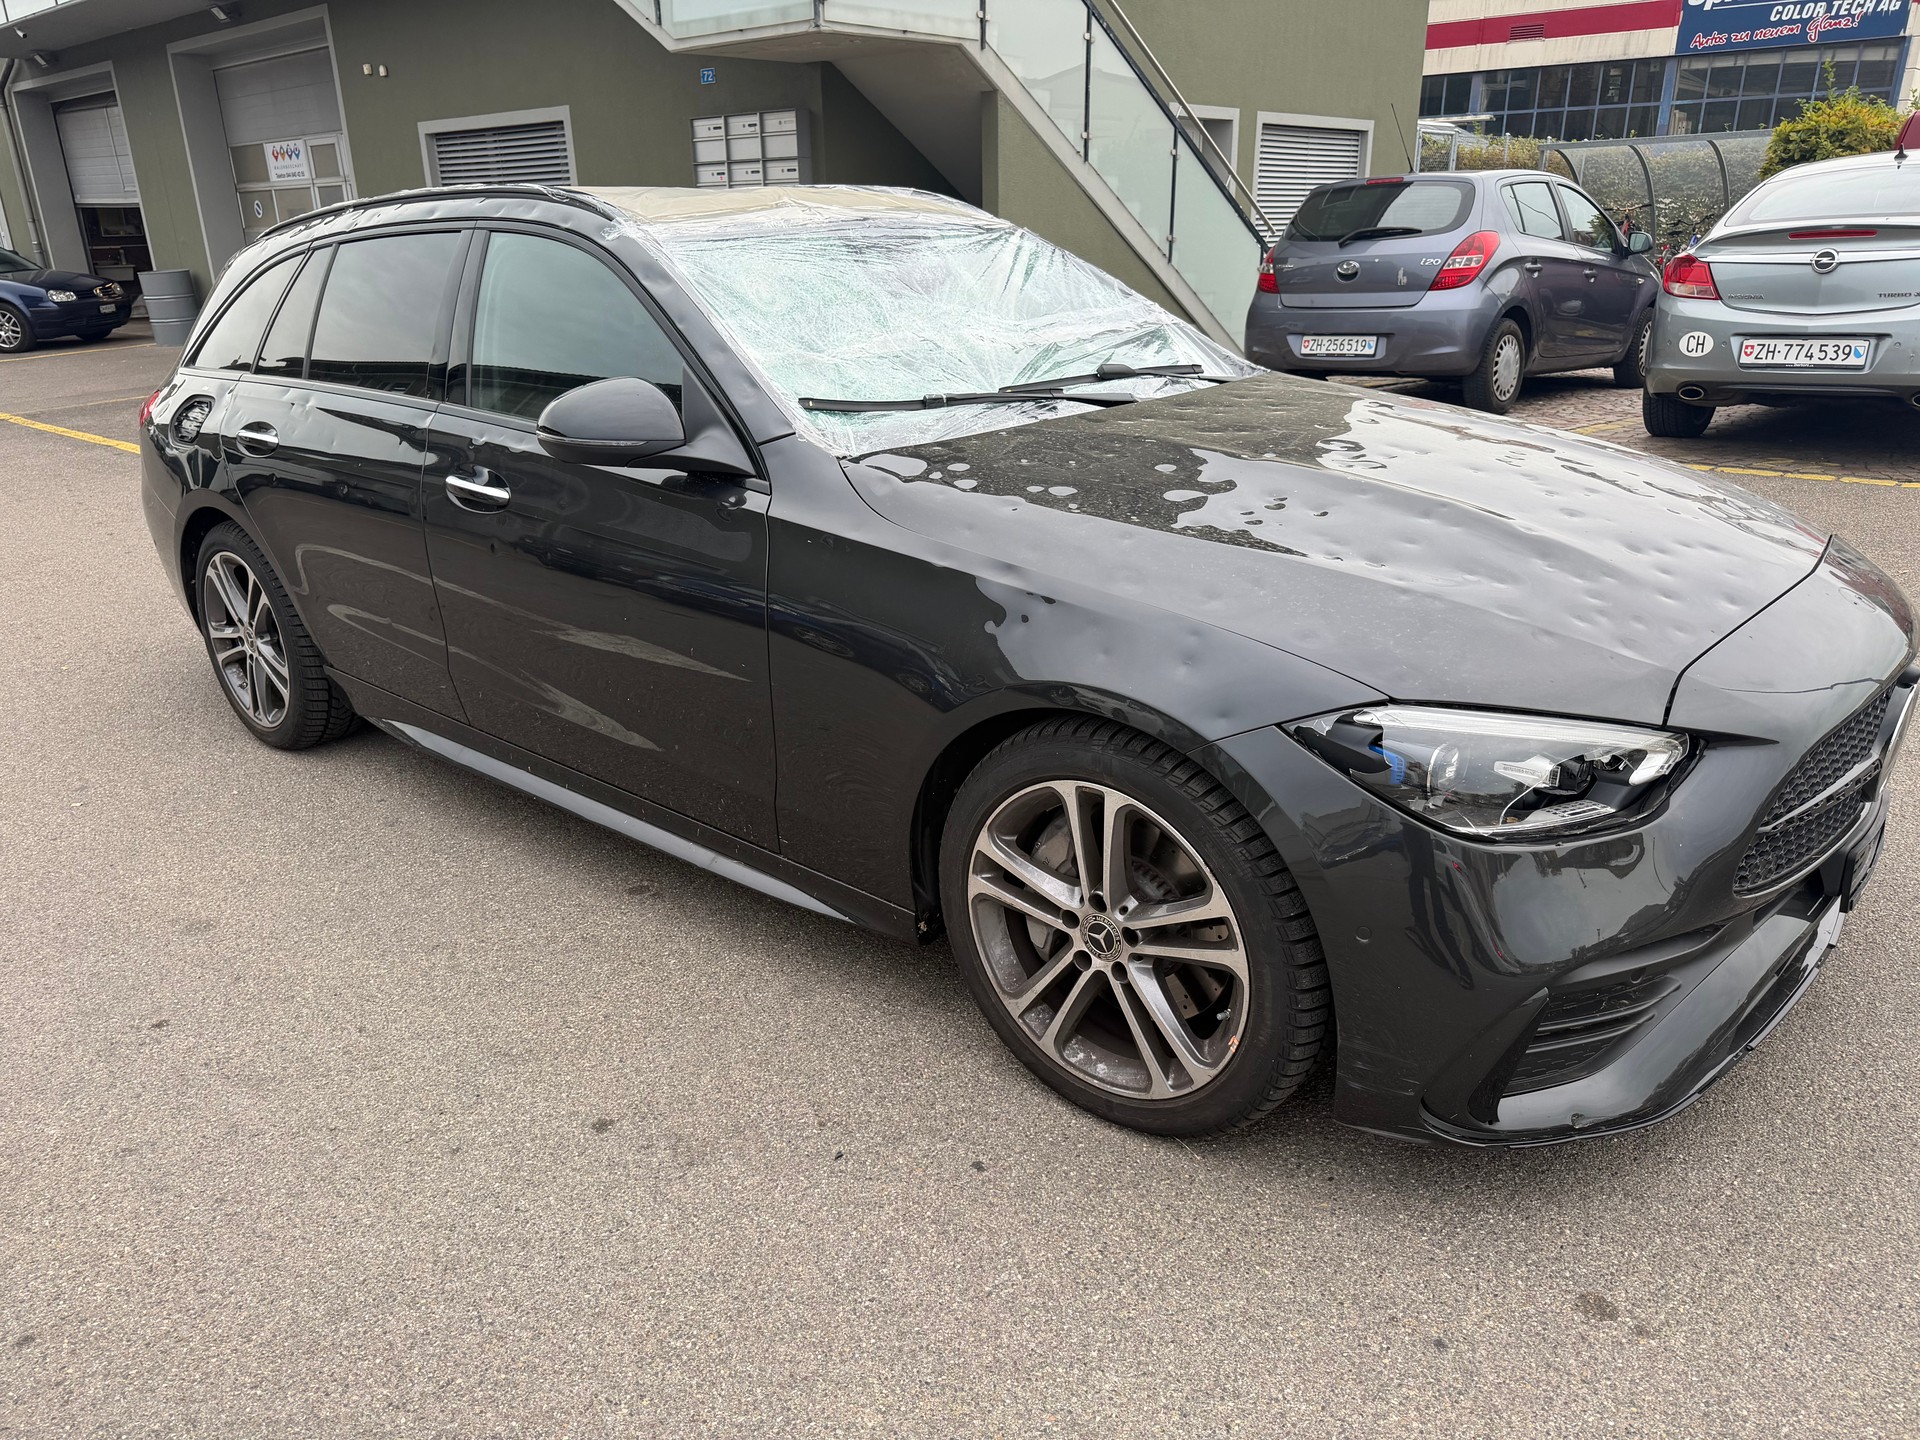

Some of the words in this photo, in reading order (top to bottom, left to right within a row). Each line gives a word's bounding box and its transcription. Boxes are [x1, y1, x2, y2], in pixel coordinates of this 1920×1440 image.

[1770, 2, 1827, 21] COLOR
[1831, 0, 1876, 15] TECH
[1877, 0, 1901, 11] AG
[1690, 30, 1728, 49] Autos
[1731, 31, 1751, 42] zu
[1753, 24, 1802, 40] neuem
[703, 70, 713, 81] 72
[1686, 335, 1706, 353] CH
